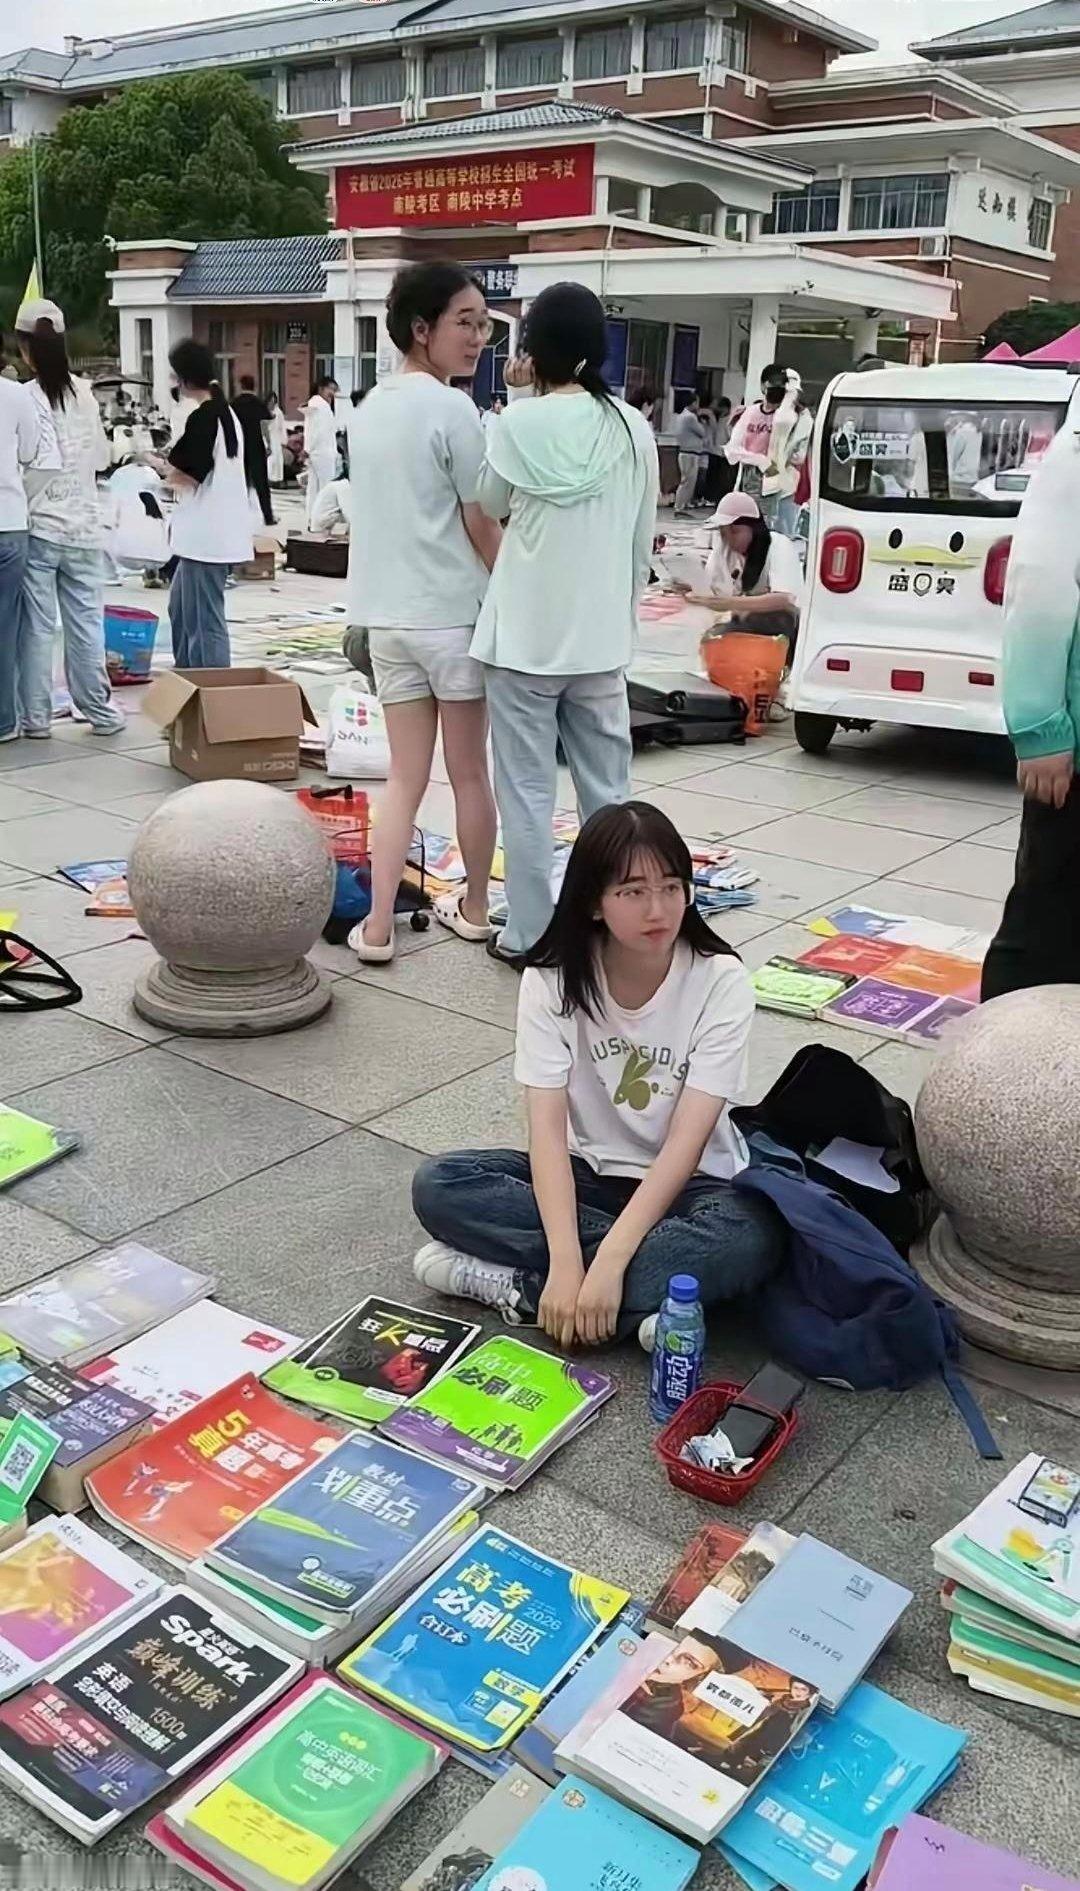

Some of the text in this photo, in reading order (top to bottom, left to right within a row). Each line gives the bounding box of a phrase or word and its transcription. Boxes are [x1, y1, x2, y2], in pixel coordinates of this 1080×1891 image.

[349, 158, 576, 193] 安徽省2026年普通高等学校招生全国统一考试
[393, 187, 523, 214] 南陵考区 南陵中学考点
[451, 1365, 549, 1412] 必刷题
[312, 1466, 421, 1527] 划重点
[455, 1559, 533, 1610] 高考
[419, 1612, 468, 1645] 合订本
[433, 1586, 546, 1656] 必刷题
[523, 1607, 562, 1631] 2026
[160, 1614, 256, 1684] Spark
[92, 1661, 134, 1693] 英语
[126, 1638, 226, 1710] 巅峰训练
[492, 1676, 526, 1697] 数学
[706, 1682, 756, 1714] 雾都孤儿
[295, 1729, 383, 1781] 高中英语词汇
